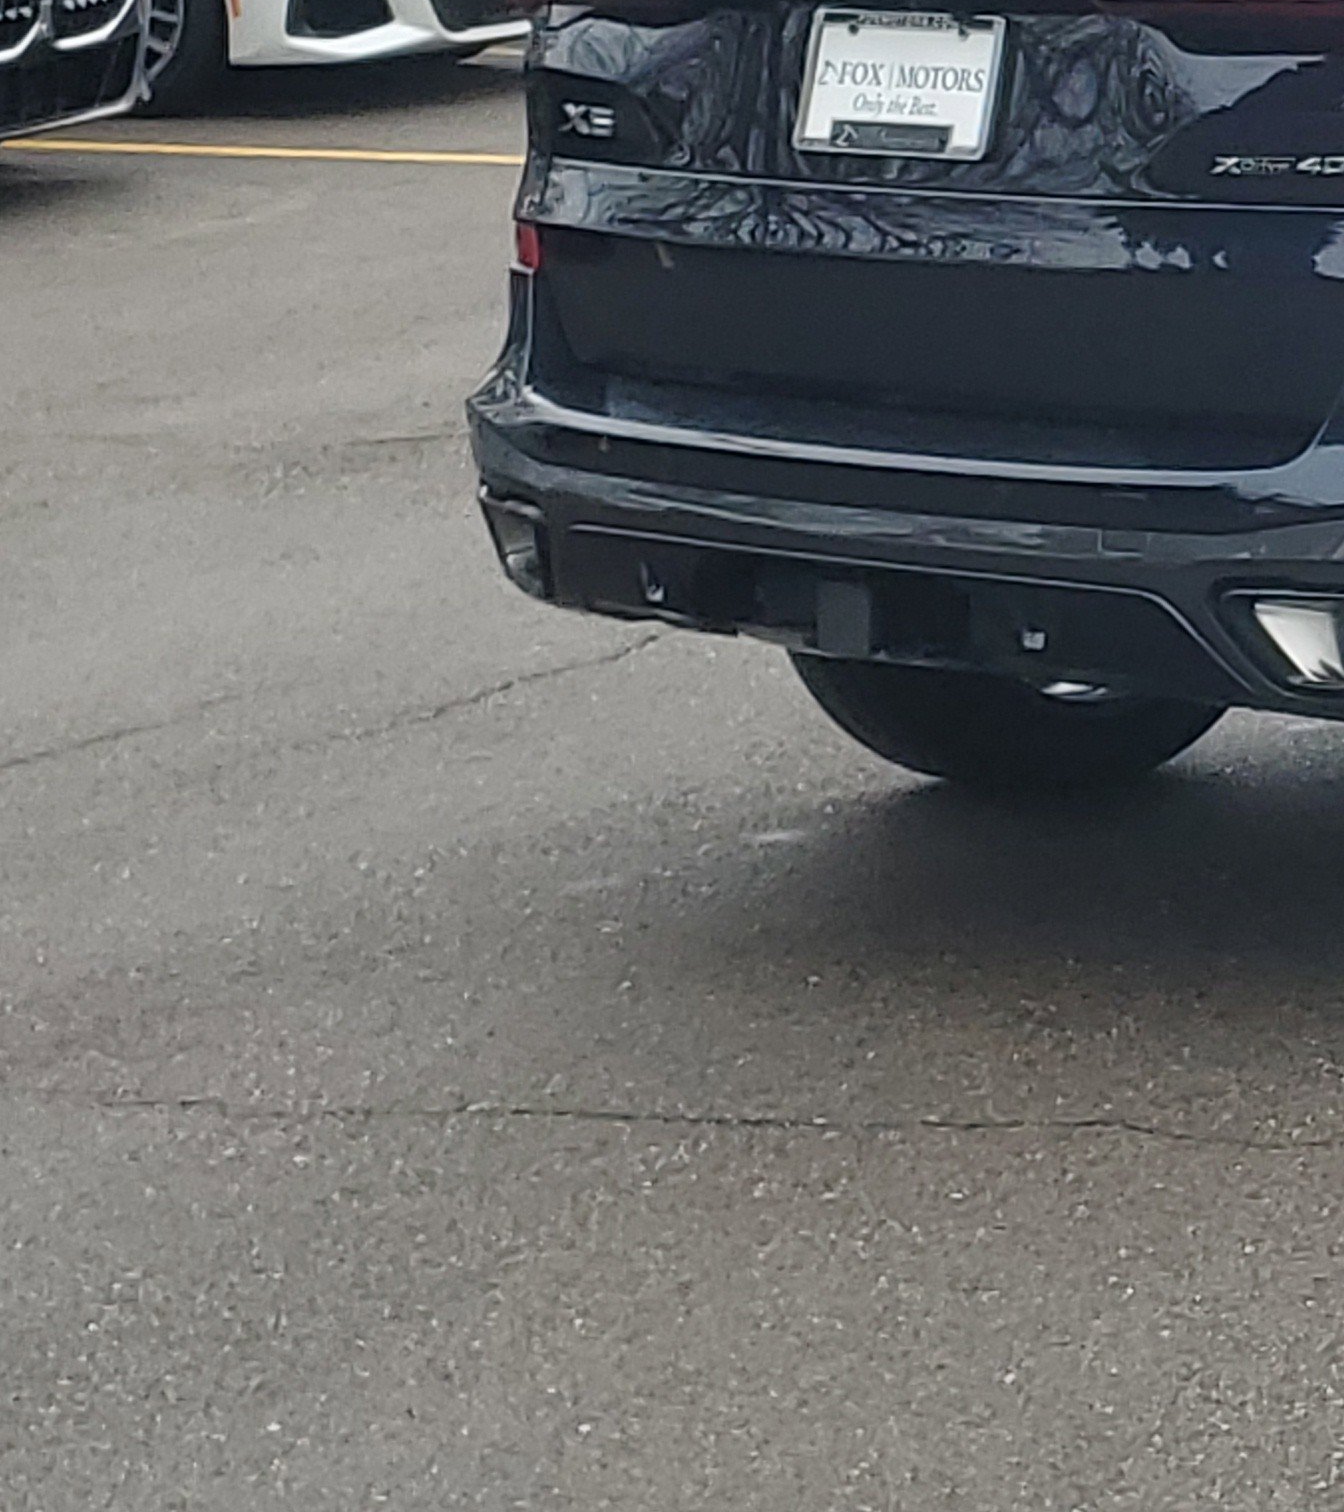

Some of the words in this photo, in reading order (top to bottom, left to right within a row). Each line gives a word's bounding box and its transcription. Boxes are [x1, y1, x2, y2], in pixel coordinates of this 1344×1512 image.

[838, 61, 885, 87] FOX
[898, 64, 986, 93] MOTORS
[559, 103, 616, 137] X5
[852, 92, 883, 117] Only
[886, 94, 907, 114] the
